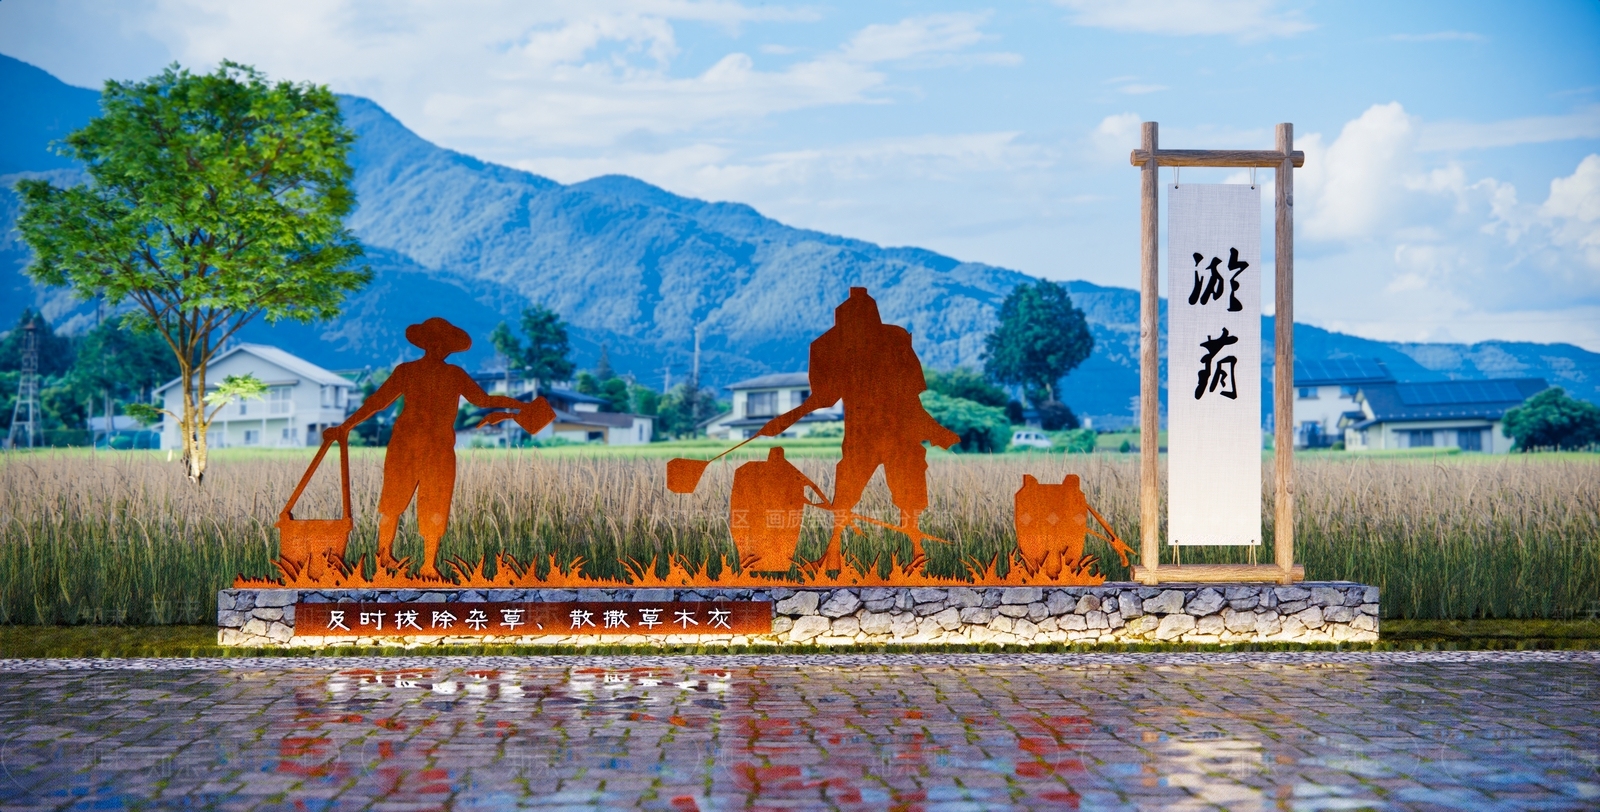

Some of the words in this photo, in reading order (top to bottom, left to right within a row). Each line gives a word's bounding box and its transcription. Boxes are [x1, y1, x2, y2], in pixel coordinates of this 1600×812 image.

[327, 608, 732, 631] 及时拔除杂草、散撒草木灰
